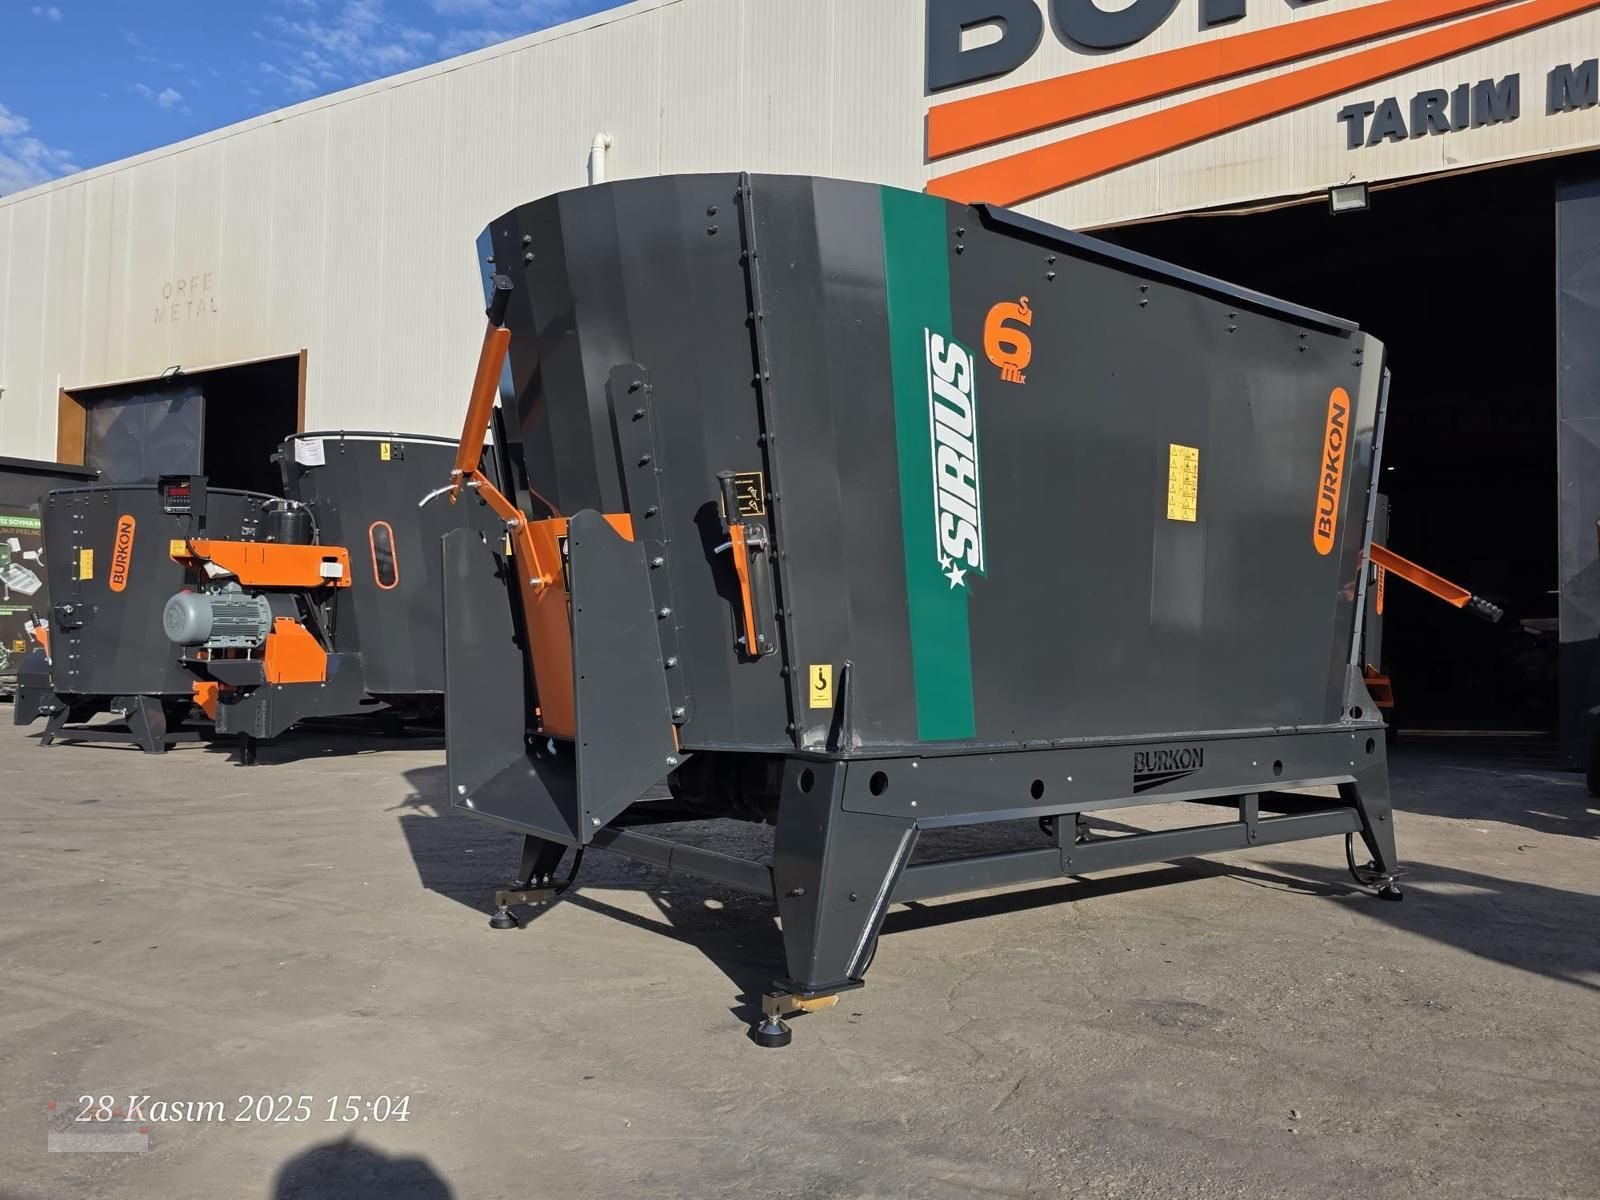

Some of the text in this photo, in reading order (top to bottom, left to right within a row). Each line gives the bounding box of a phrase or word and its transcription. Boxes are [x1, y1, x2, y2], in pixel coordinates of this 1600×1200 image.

[1337, 73, 1520, 150] TARIM
[162, 272, 213, 299] ORFE
[984, 302, 1032, 369] 6
[930, 333, 980, 568] SIRIUS
[1317, 403, 1346, 540] BURKON
[113, 522, 132, 584] BURKON
[1133, 747, 1204, 773] BURKON
